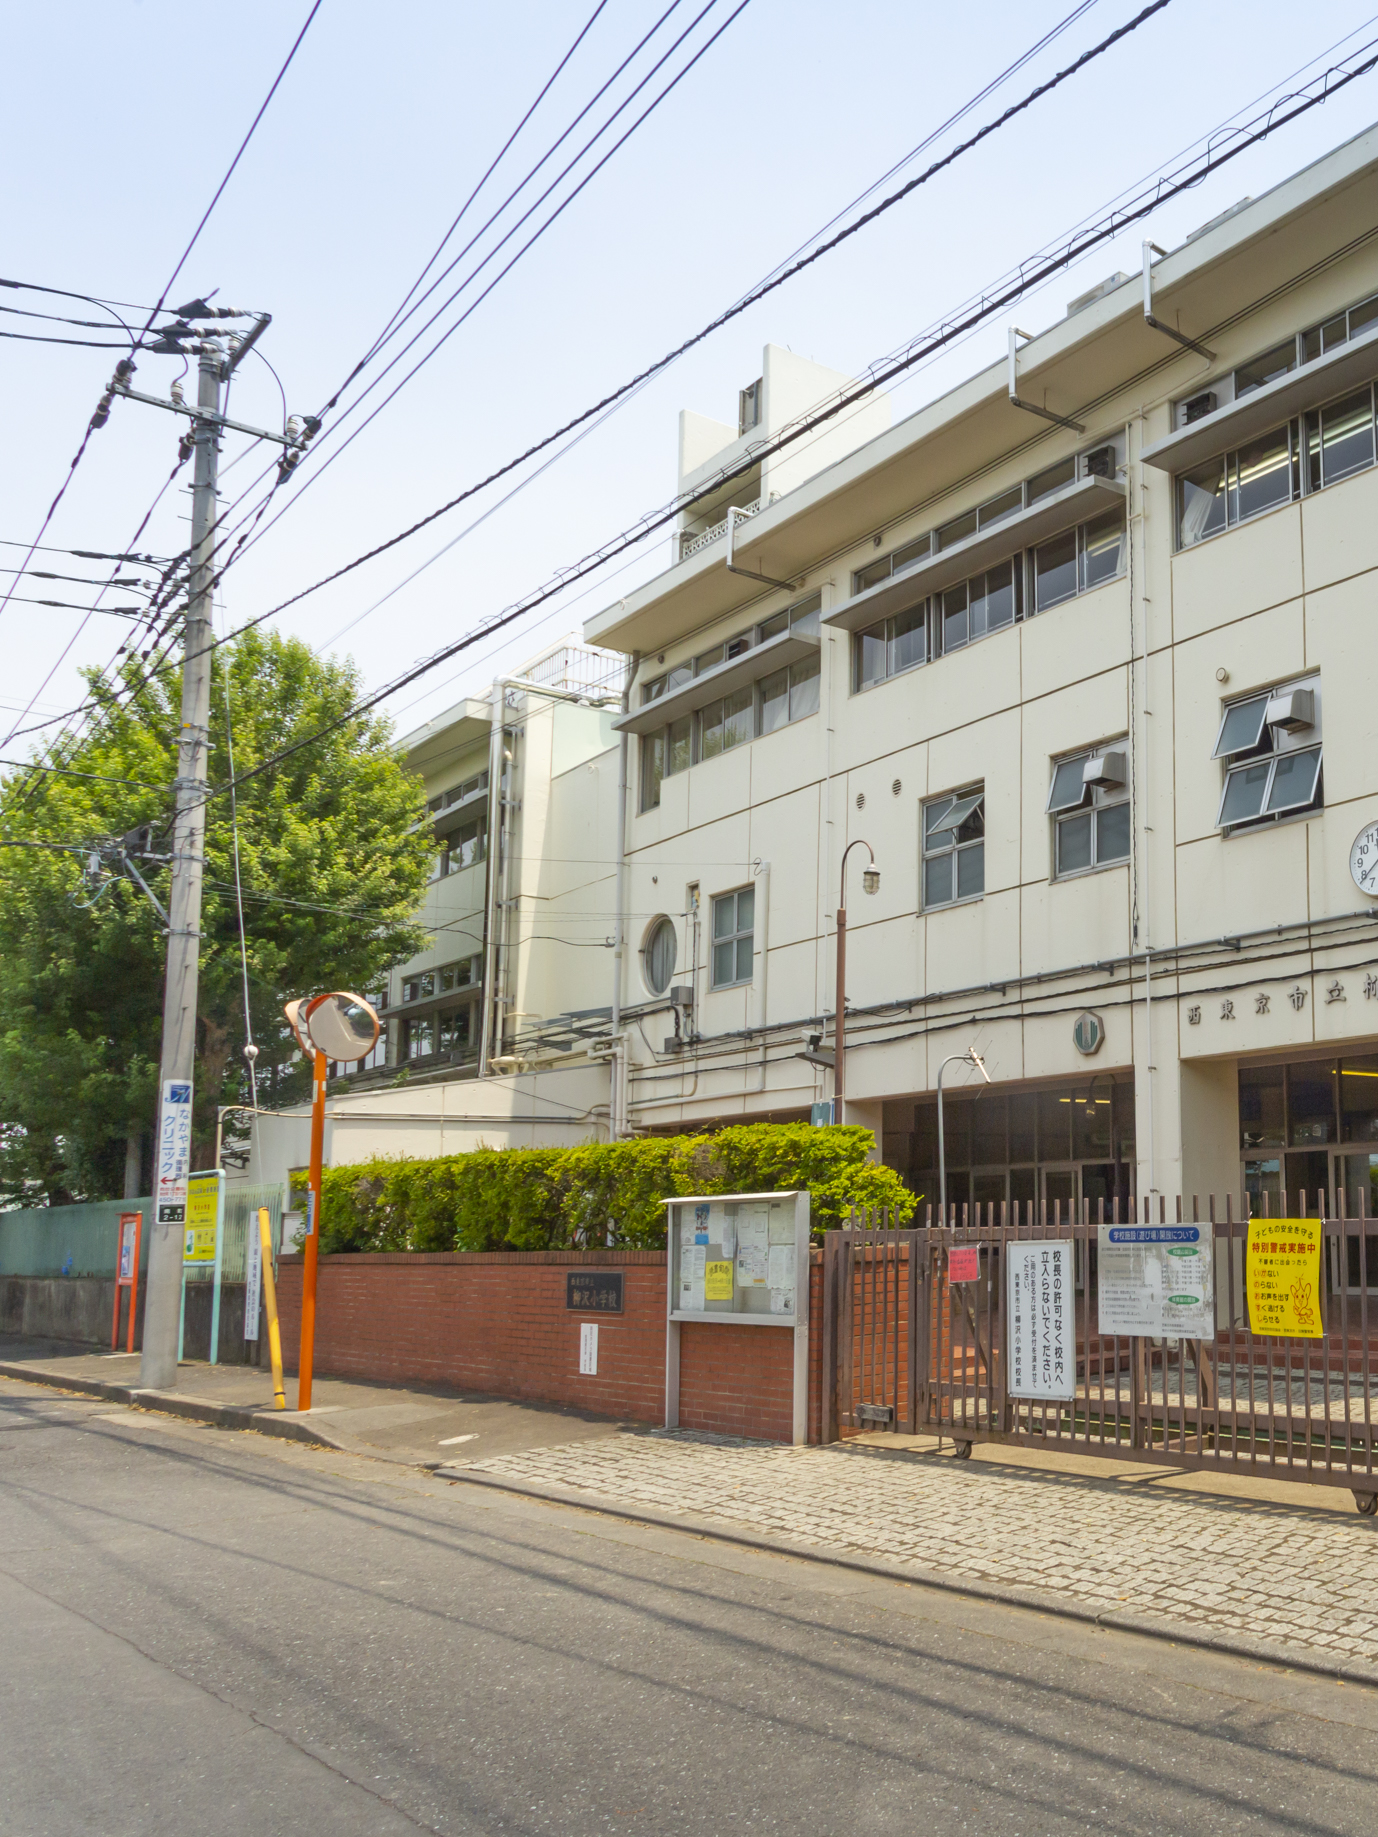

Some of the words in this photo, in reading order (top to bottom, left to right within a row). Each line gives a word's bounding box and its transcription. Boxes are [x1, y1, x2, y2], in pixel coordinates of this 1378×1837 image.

[1365, 833, 1374, 843] 11
[1359, 844, 1369, 855] 10
[1357, 857, 1363, 868] 9
[1361, 869, 1367, 880] 8
[1369, 877, 1376, 888] 7
[178, 1108, 190, 1158] なかやま
[162, 1115, 176, 1173] クリニック
[1255, 1225, 1314, 1240] 子どもの安全を守る
[1252, 1242, 1316, 1254] 特別警戒実施中
[1258, 1258, 1308, 1266] 不審者に出会ったら
[1253, 1269, 1280, 1278] いかない
[1254, 1281, 1278, 1289] のらない
[572, 1288, 617, 1307] 柳沢小学校
[1041, 1251, 1051, 1389] 立入らないでください。
[1053, 1250, 1063, 1385] 校長の許可なく校内へ
[1257, 1314, 1280, 1324] しらせる
